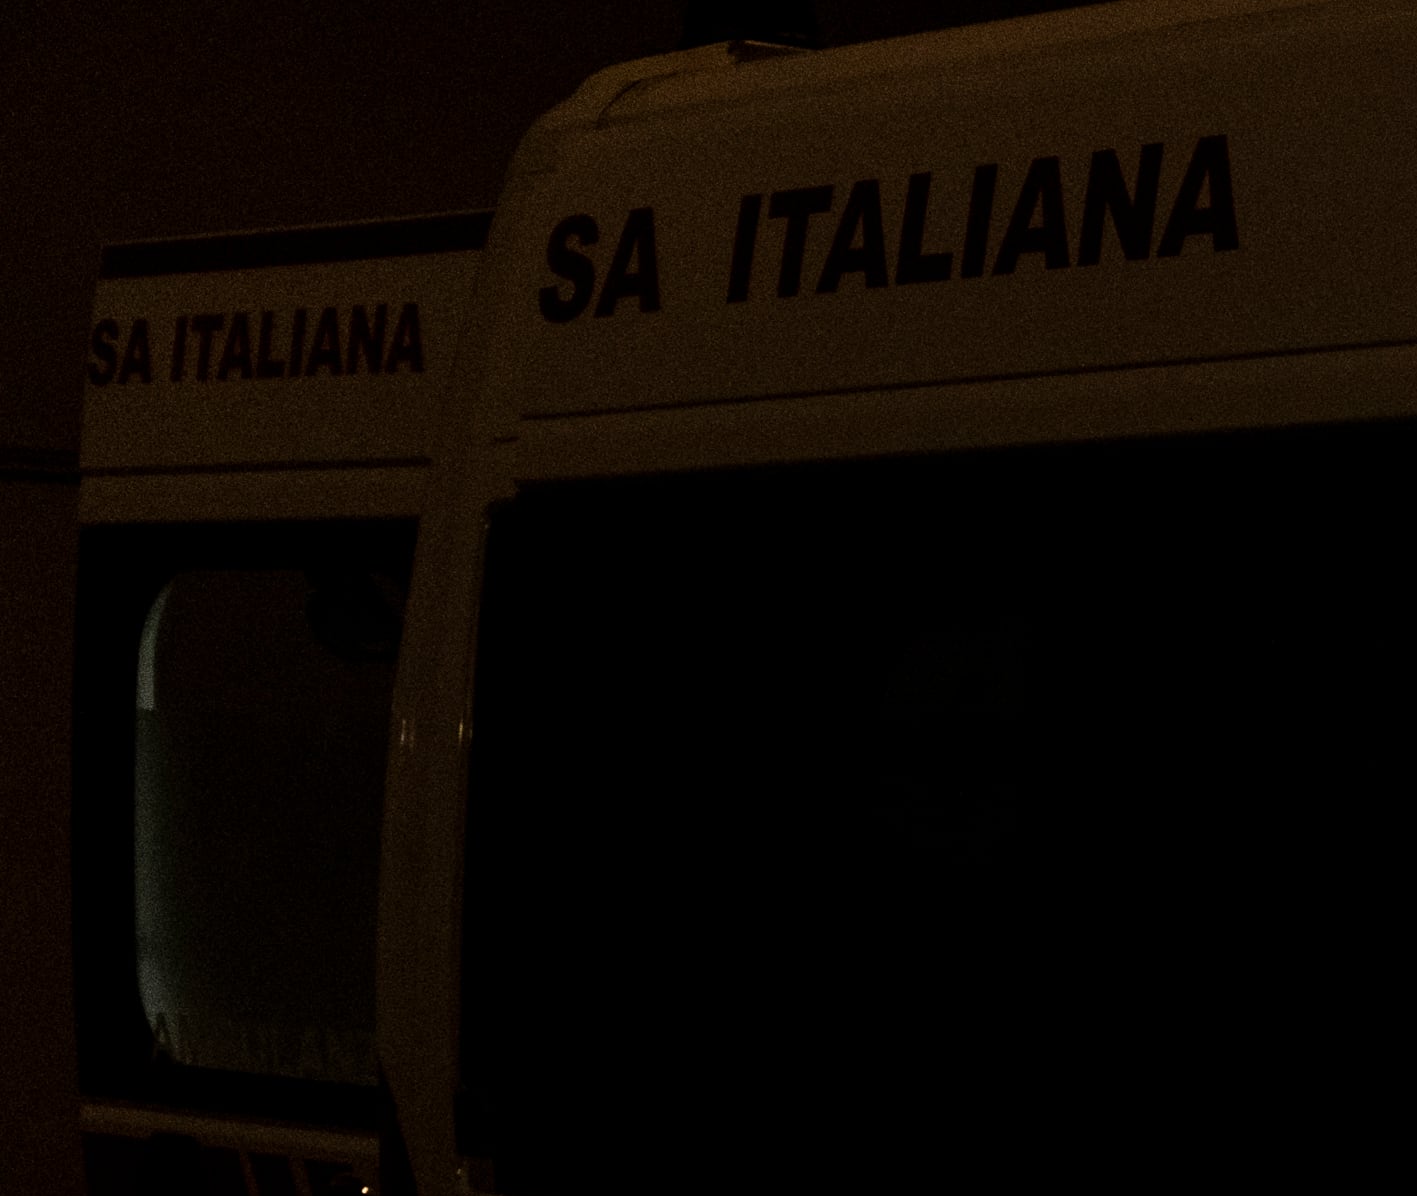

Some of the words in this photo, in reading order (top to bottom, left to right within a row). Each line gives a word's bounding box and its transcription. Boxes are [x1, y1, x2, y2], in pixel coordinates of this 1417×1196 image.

[540, 206, 663, 323] SA
[726, 134, 1241, 304] ITALIANA
[87, 317, 153, 386] SA
[170, 302, 425, 381] ITALIANA
